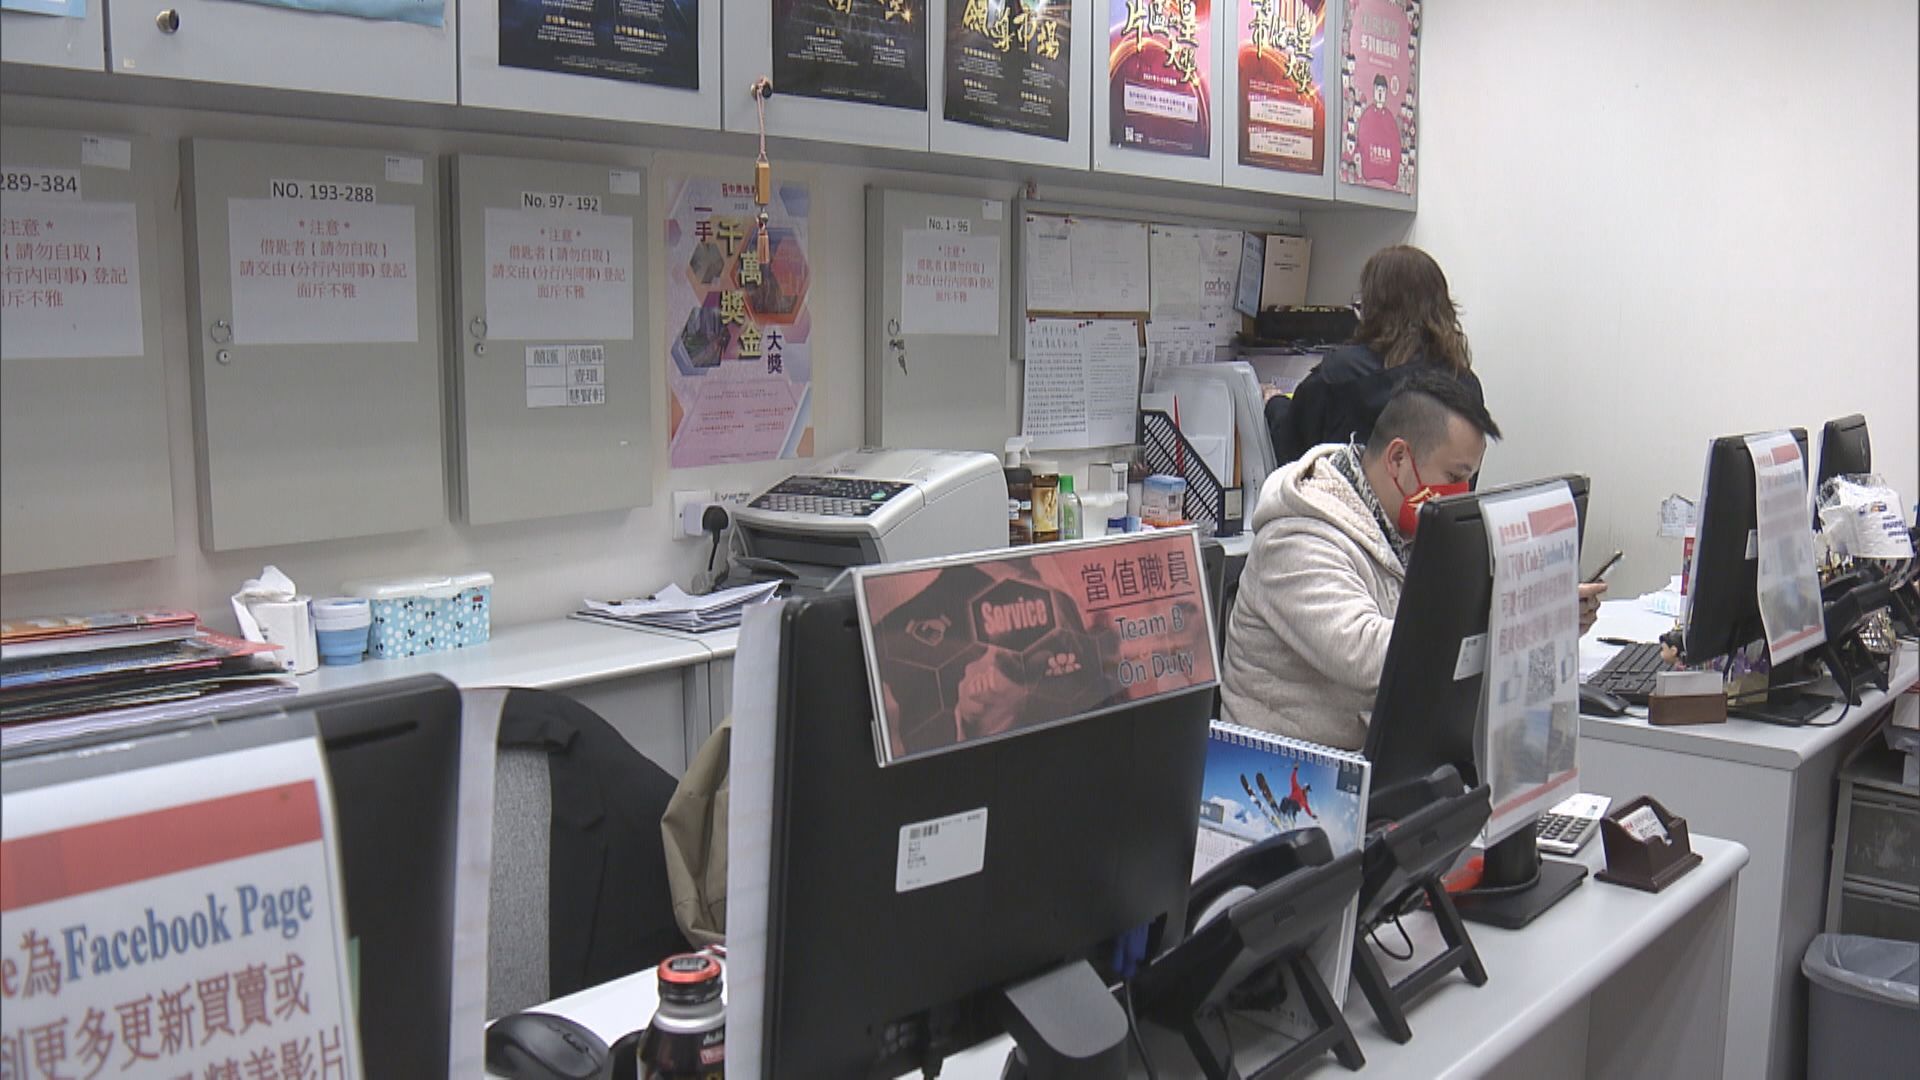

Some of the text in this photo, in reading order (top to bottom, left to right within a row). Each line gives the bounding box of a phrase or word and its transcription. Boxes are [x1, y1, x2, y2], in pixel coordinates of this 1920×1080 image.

[273, 182, 374, 202] NO. 193-288
[524, 193, 546, 208] No.
[549, 195, 564, 208] 97
[577, 197, 598, 212] 192
[929, 217, 943, 230] No.
[1081, 551, 1192, 603] 當值職員
[981, 596, 1048, 636] Service
[1115, 615, 1167, 640] Team
[1118, 650, 1193, 685] On Duty
[236, 884, 313, 941] Page
